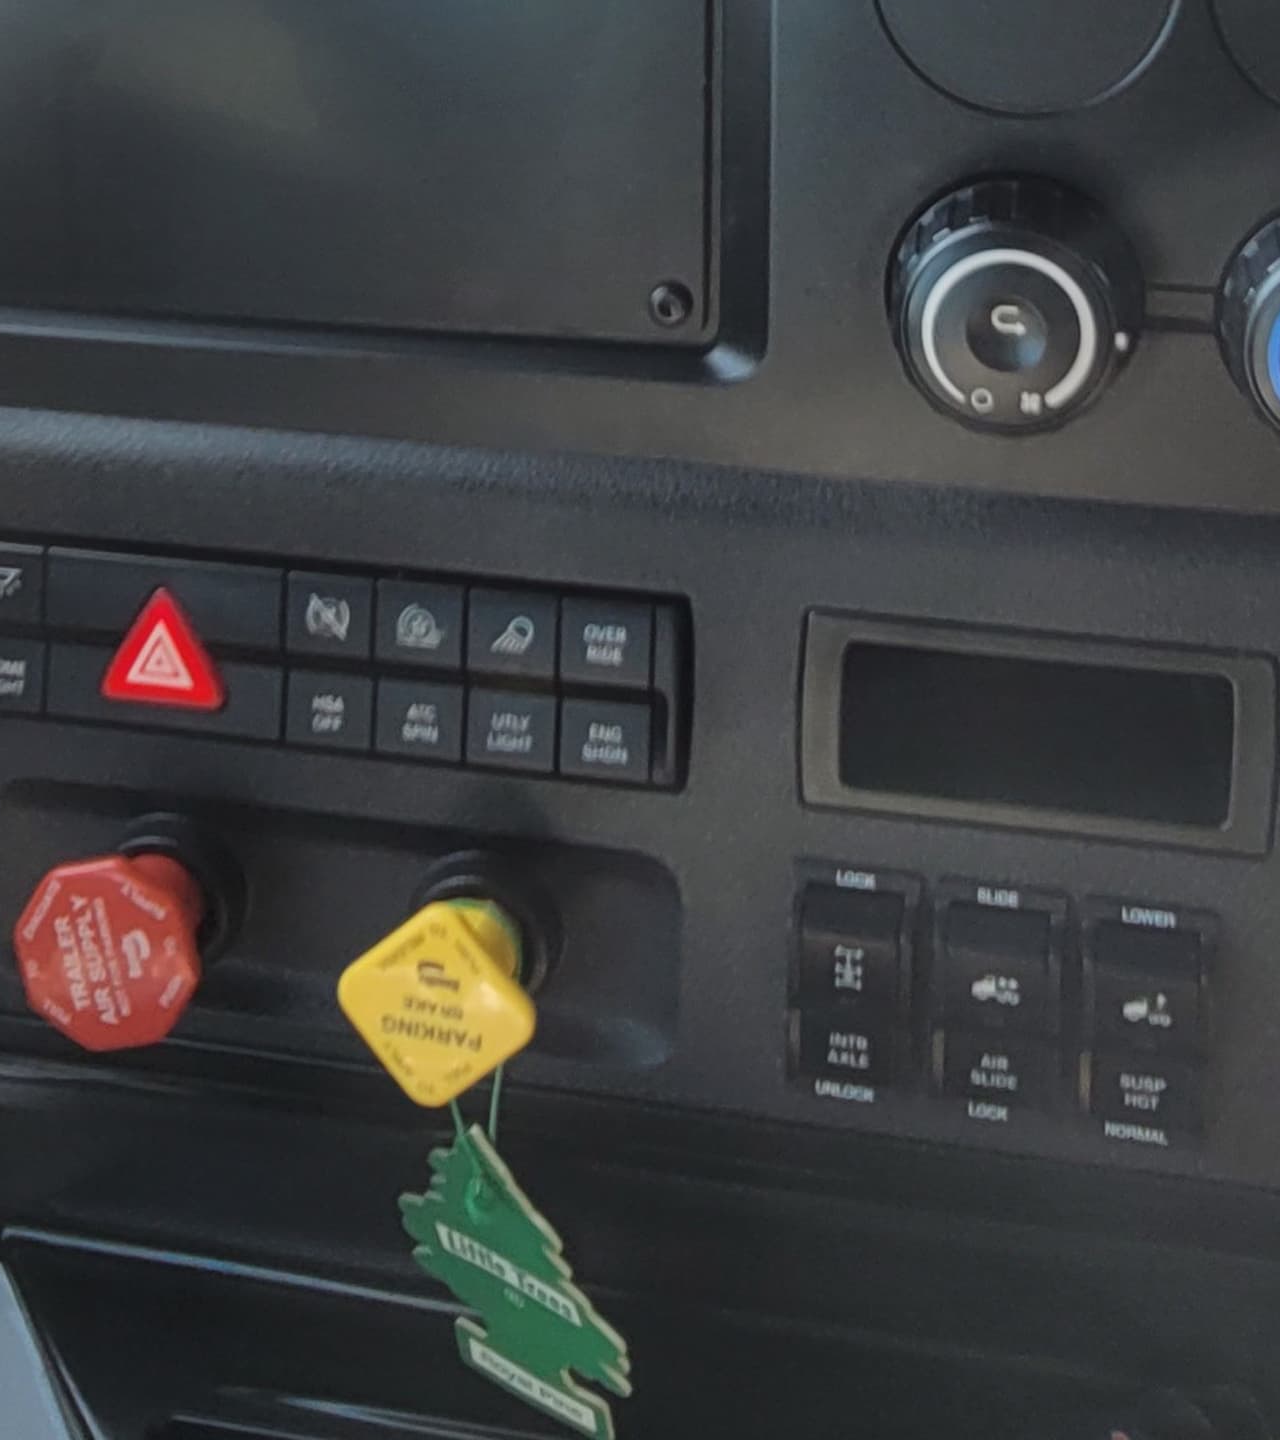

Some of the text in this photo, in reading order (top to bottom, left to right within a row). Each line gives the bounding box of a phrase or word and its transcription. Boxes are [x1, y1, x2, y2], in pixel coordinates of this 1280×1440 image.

[582, 622, 628, 643] OVER
[311, 713, 342, 734] OFF
[401, 722, 440, 744] SPIN
[587, 721, 623, 743] ENG
[486, 732, 533, 754] LIGHT
[834, 868, 877, 891] LOCK
[976, 886, 1020, 909] SLIDE
[1120, 904, 1177, 929] LOWER
[53, 915, 91, 1011] TRAILER
[70, 893, 120, 1025] AIR SUPPLY
[380, 1014, 484, 1052] PARKING
[826, 1050, 870, 1070] AXLE
[979, 1052, 1010, 1071] AIR
[814, 1078, 876, 1104] UNLOCK
[969, 1070, 1019, 1091] SLIDE
[1118, 1072, 1168, 1093] SUSP
[967, 1100, 1010, 1122] LOCK
[1123, 1092, 1161, 1112] HGT
[1103, 1121, 1171, 1147] NORMAL
[444, 1228, 506, 1279] Little
[517, 1268, 574, 1320] Trees
